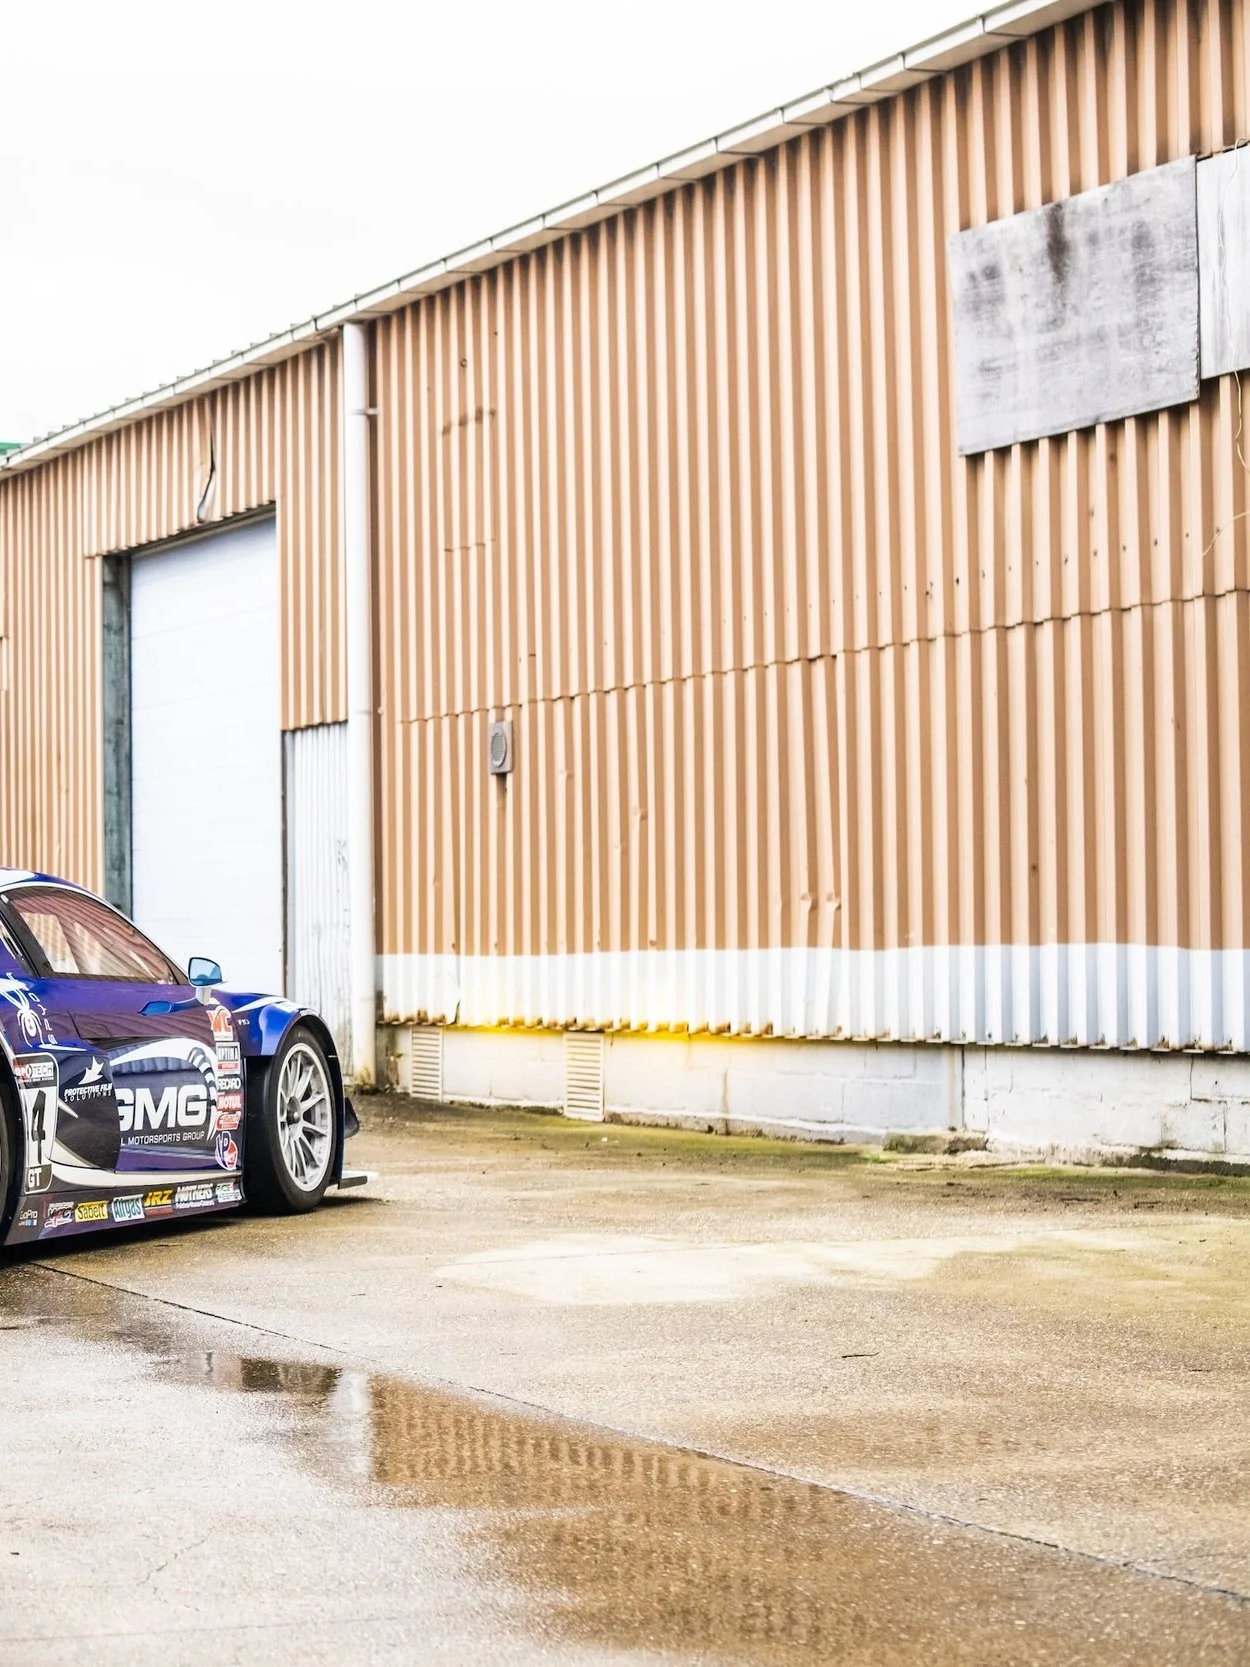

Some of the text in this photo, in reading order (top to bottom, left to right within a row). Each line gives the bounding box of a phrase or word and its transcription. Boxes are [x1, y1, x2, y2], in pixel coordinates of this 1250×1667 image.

[64, 1082, 112, 1097] PROTECTIVE FILM
[64, 1090, 112, 1103] SOLUTIONS
[217, 1094, 241, 1109] MOTUL
[127, 1133, 181, 1146] MOTORSPORTS
[182, 1130, 205, 1141] GROUP
[28, 1168, 42, 1188] GT
[143, 1189, 173, 1207] JRZ
[78, 1203, 106, 1220] Sabelt
[113, 1198, 142, 1220] Airgas
